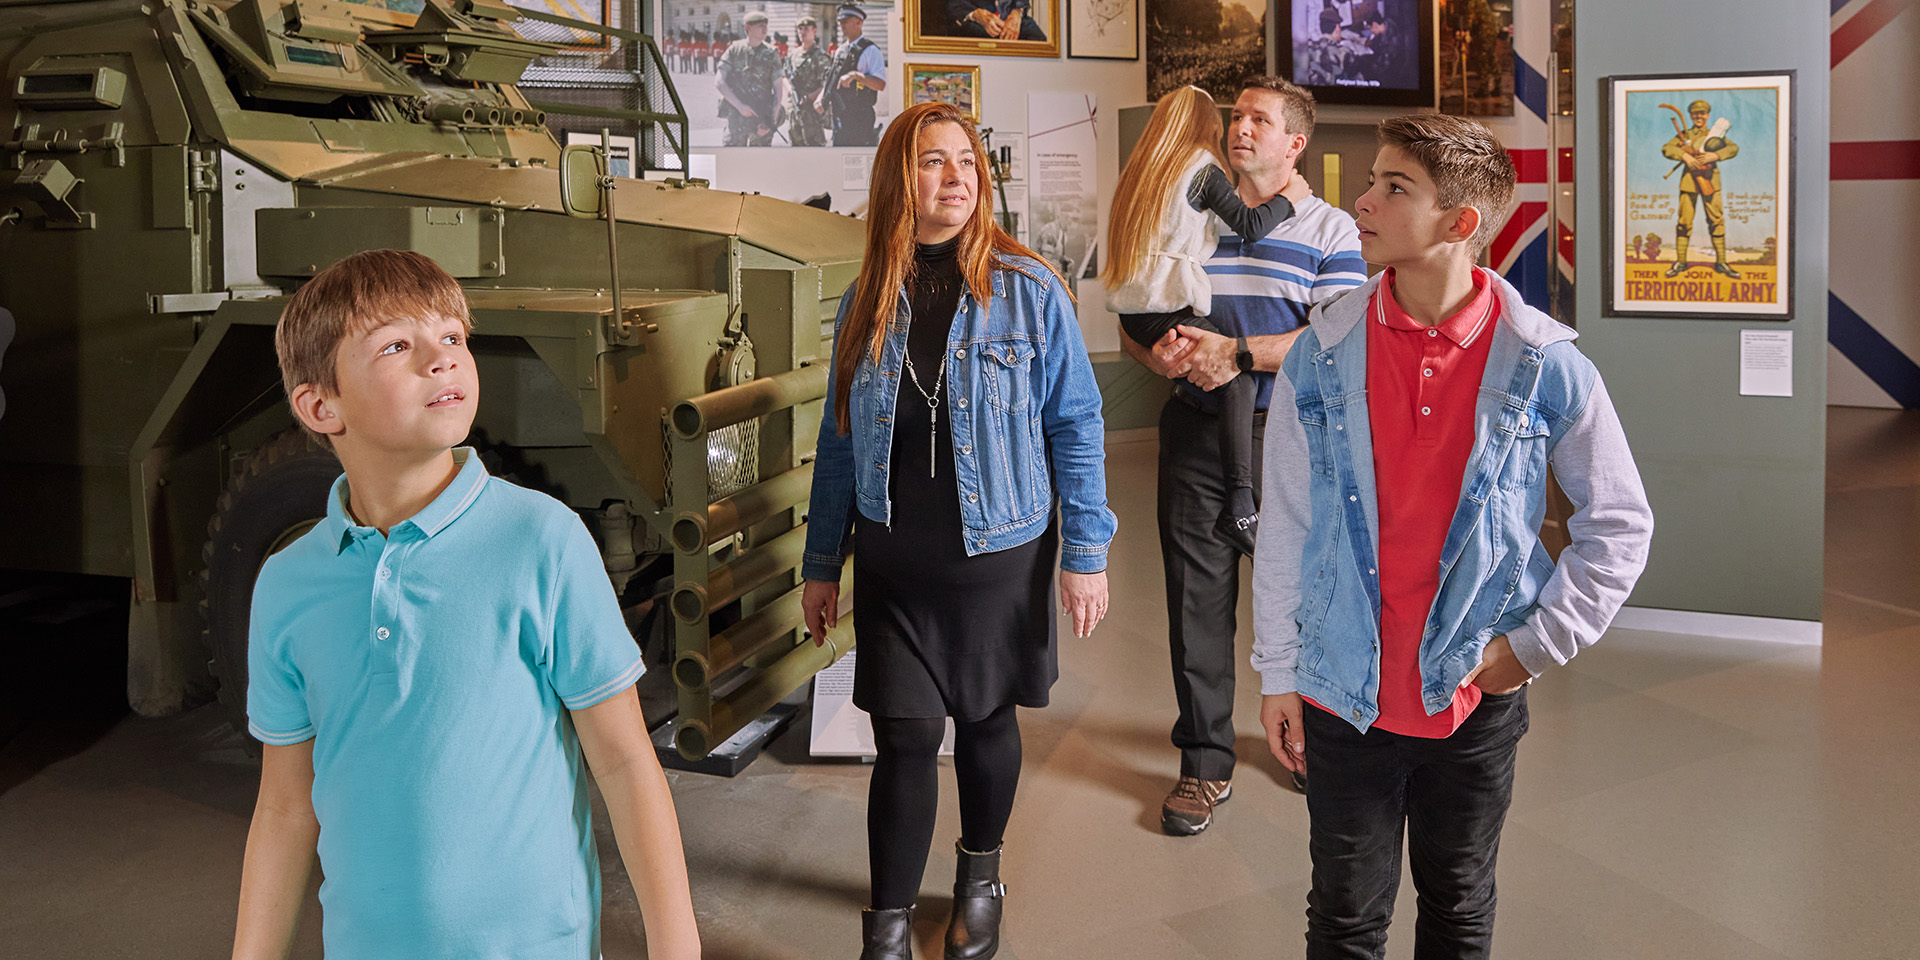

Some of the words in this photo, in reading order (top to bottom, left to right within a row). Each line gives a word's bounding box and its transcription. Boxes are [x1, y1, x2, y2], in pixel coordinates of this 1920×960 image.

[1630, 192, 1648, 200] Are
[1651, 194, 1670, 202] you
[1630, 201, 1654, 209] fond
[1658, 201, 1670, 209] of
[1630, 208, 1675, 220] Games?
[1633, 270, 1658, 279] THEN
[1684, 271, 1713, 279] JOIN
[1745, 272, 1768, 280] THE
[1626, 281, 1724, 301] TERRITORIAL
[1729, 282, 1776, 302] ARMY
